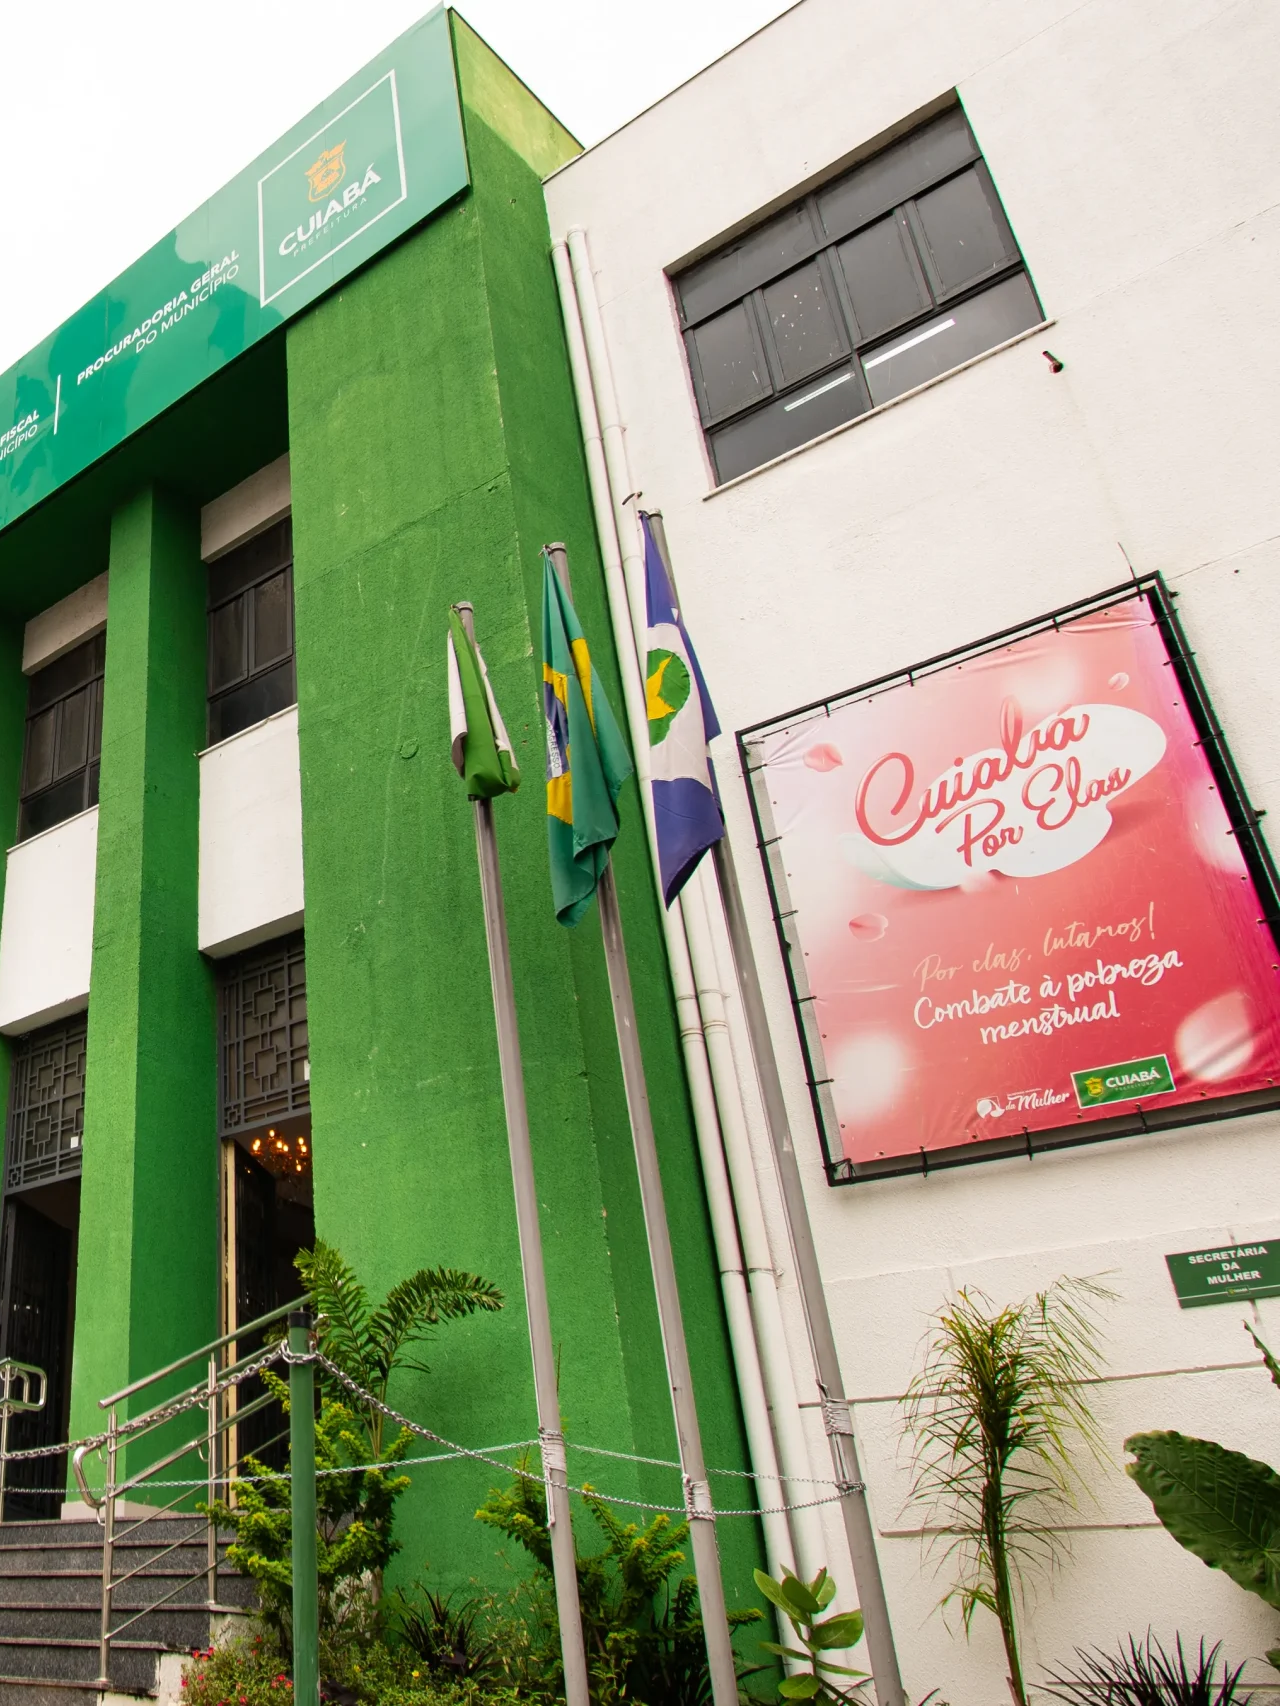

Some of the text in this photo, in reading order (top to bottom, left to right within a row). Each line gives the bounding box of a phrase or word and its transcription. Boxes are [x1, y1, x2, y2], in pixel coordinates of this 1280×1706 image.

[279, 162, 381, 256] CUIABÁ
[293, 197, 367, 257] PREFEITURA
[77, 249, 239, 385] PROCURADORIA GERAL
[135, 264, 239, 353] DO MUNICÍPIO
[0, 410, 40, 447] FISCAL
[935, 756, 1131, 867] Por Elas
[913, 954, 963, 992] Por
[1043, 901, 1156, 956] lutamos!
[913, 950, 1184, 1029] Combate à pobreza
[980, 990, 1121, 1045] menstrual
[1007, 1088, 1070, 1111] Mulher
[1105, 1066, 1162, 1088] CUIABÁ
[1005, 1101, 1016, 1111] da
[1206, 1270, 1262, 1285] MULHER
[1221, 1261, 1240, 1271] DA
